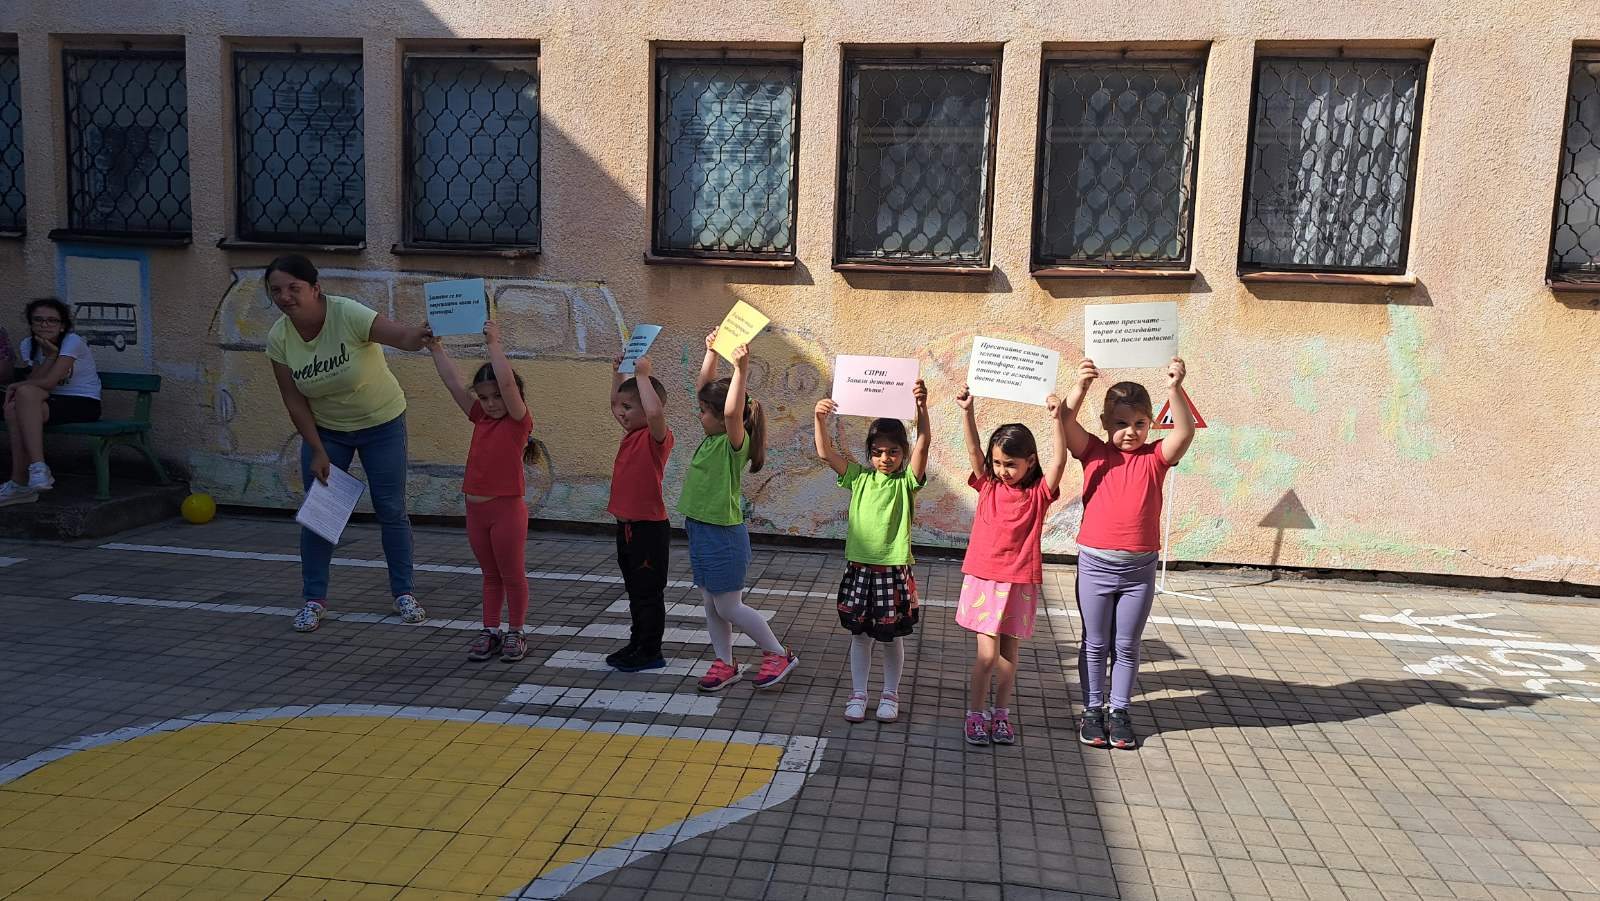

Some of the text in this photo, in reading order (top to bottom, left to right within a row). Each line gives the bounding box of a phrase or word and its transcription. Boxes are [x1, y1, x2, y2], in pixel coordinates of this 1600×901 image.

[1121, 318, 1160, 326] пресичате
[980, 342, 1022, 354] Пресичайте
[292, 342, 350, 380] weekend
[864, 369, 888, 377] СПРИ!
